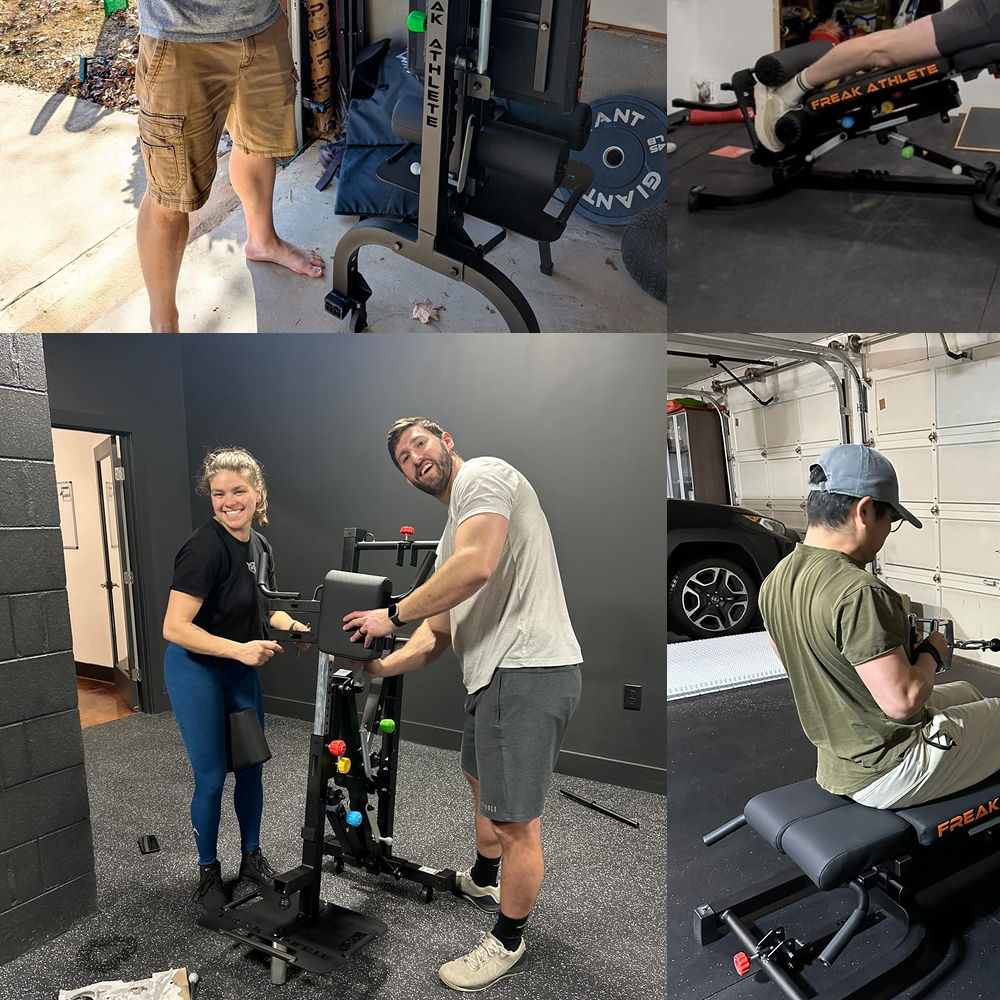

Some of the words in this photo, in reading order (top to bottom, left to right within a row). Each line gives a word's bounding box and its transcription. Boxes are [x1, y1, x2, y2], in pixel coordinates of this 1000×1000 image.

[426, 38, 444, 128] ATHLETE
[811, 86, 863, 111] FREAK
[866, 63, 939, 94] ATHLETE
[590, 107, 646, 132] ANT
[582, 171, 662, 211] GIANT
[937, 797, 999, 837] FREAK
